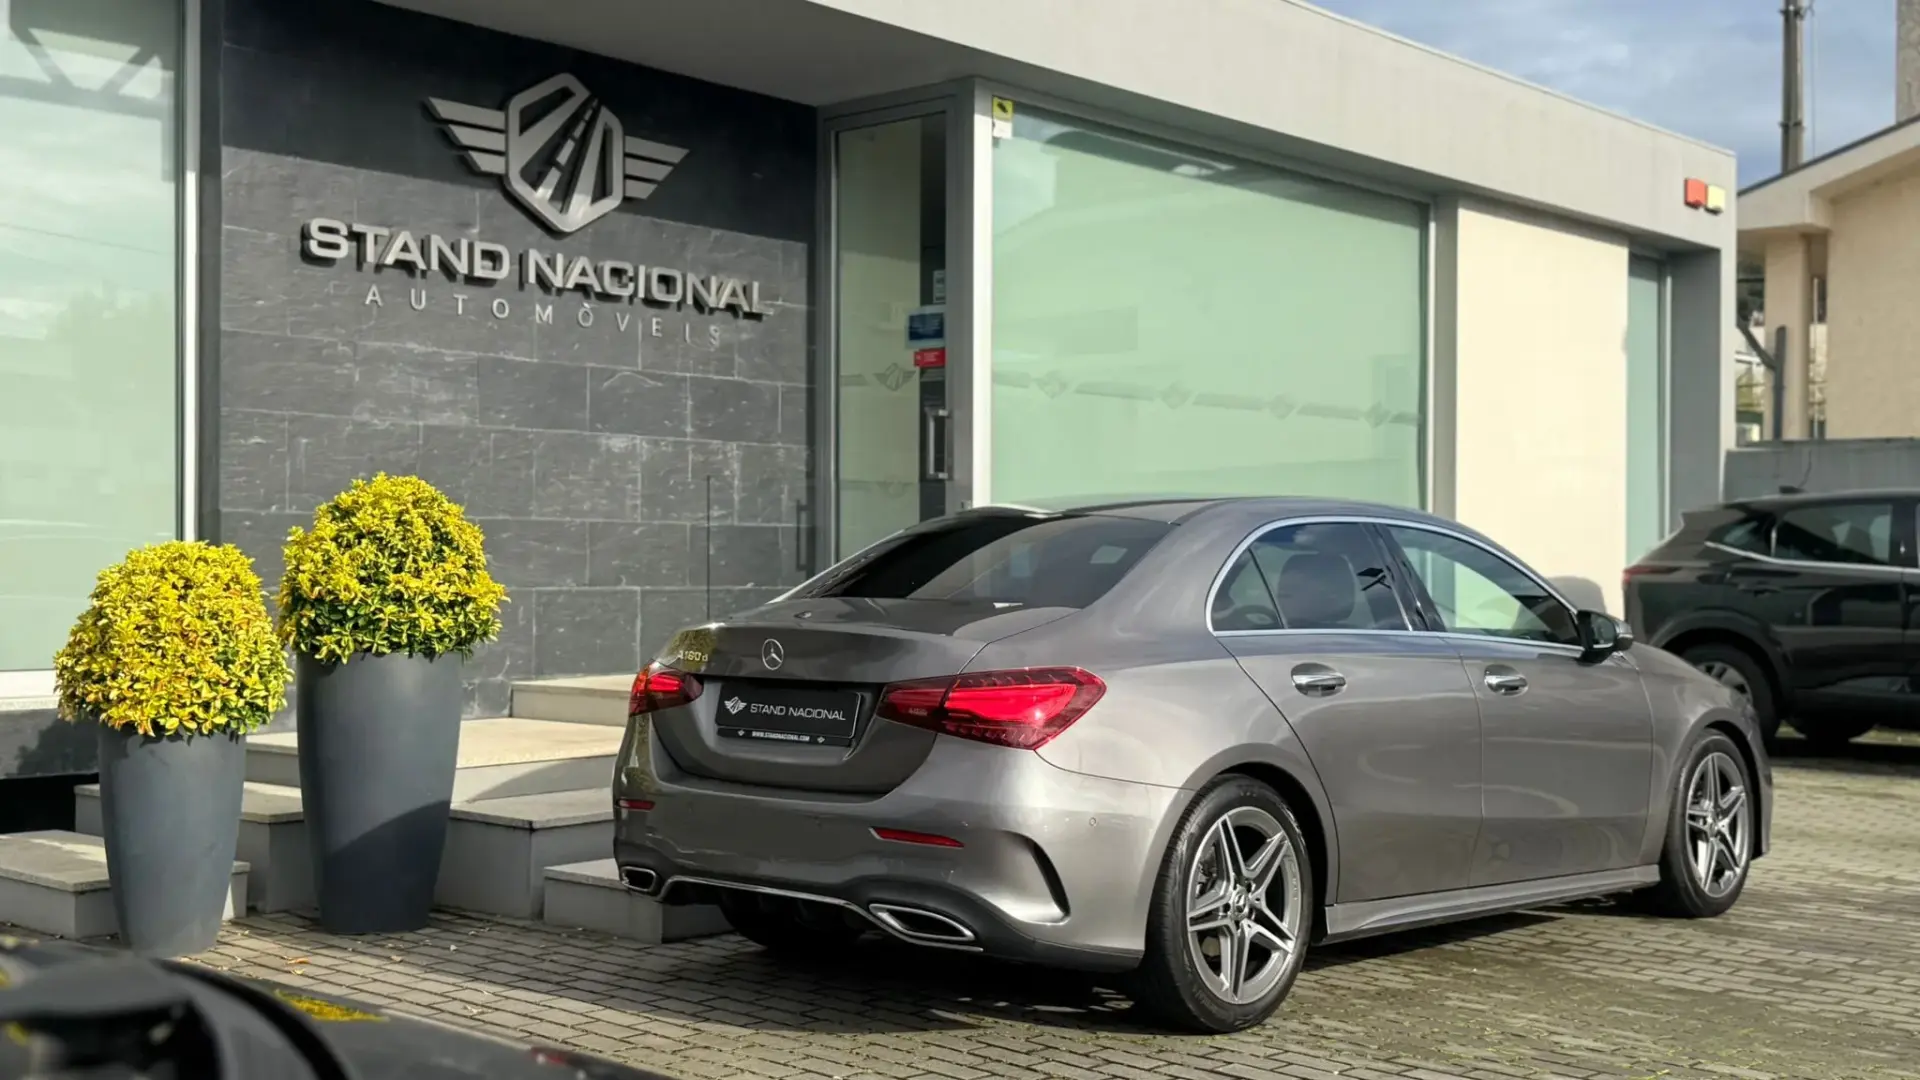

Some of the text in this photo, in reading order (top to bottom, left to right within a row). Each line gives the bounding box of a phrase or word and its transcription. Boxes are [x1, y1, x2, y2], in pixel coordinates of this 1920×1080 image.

[304, 217, 774, 317] STAND NACIONAL
[750, 703, 846, 721] STAND NACIONAL
